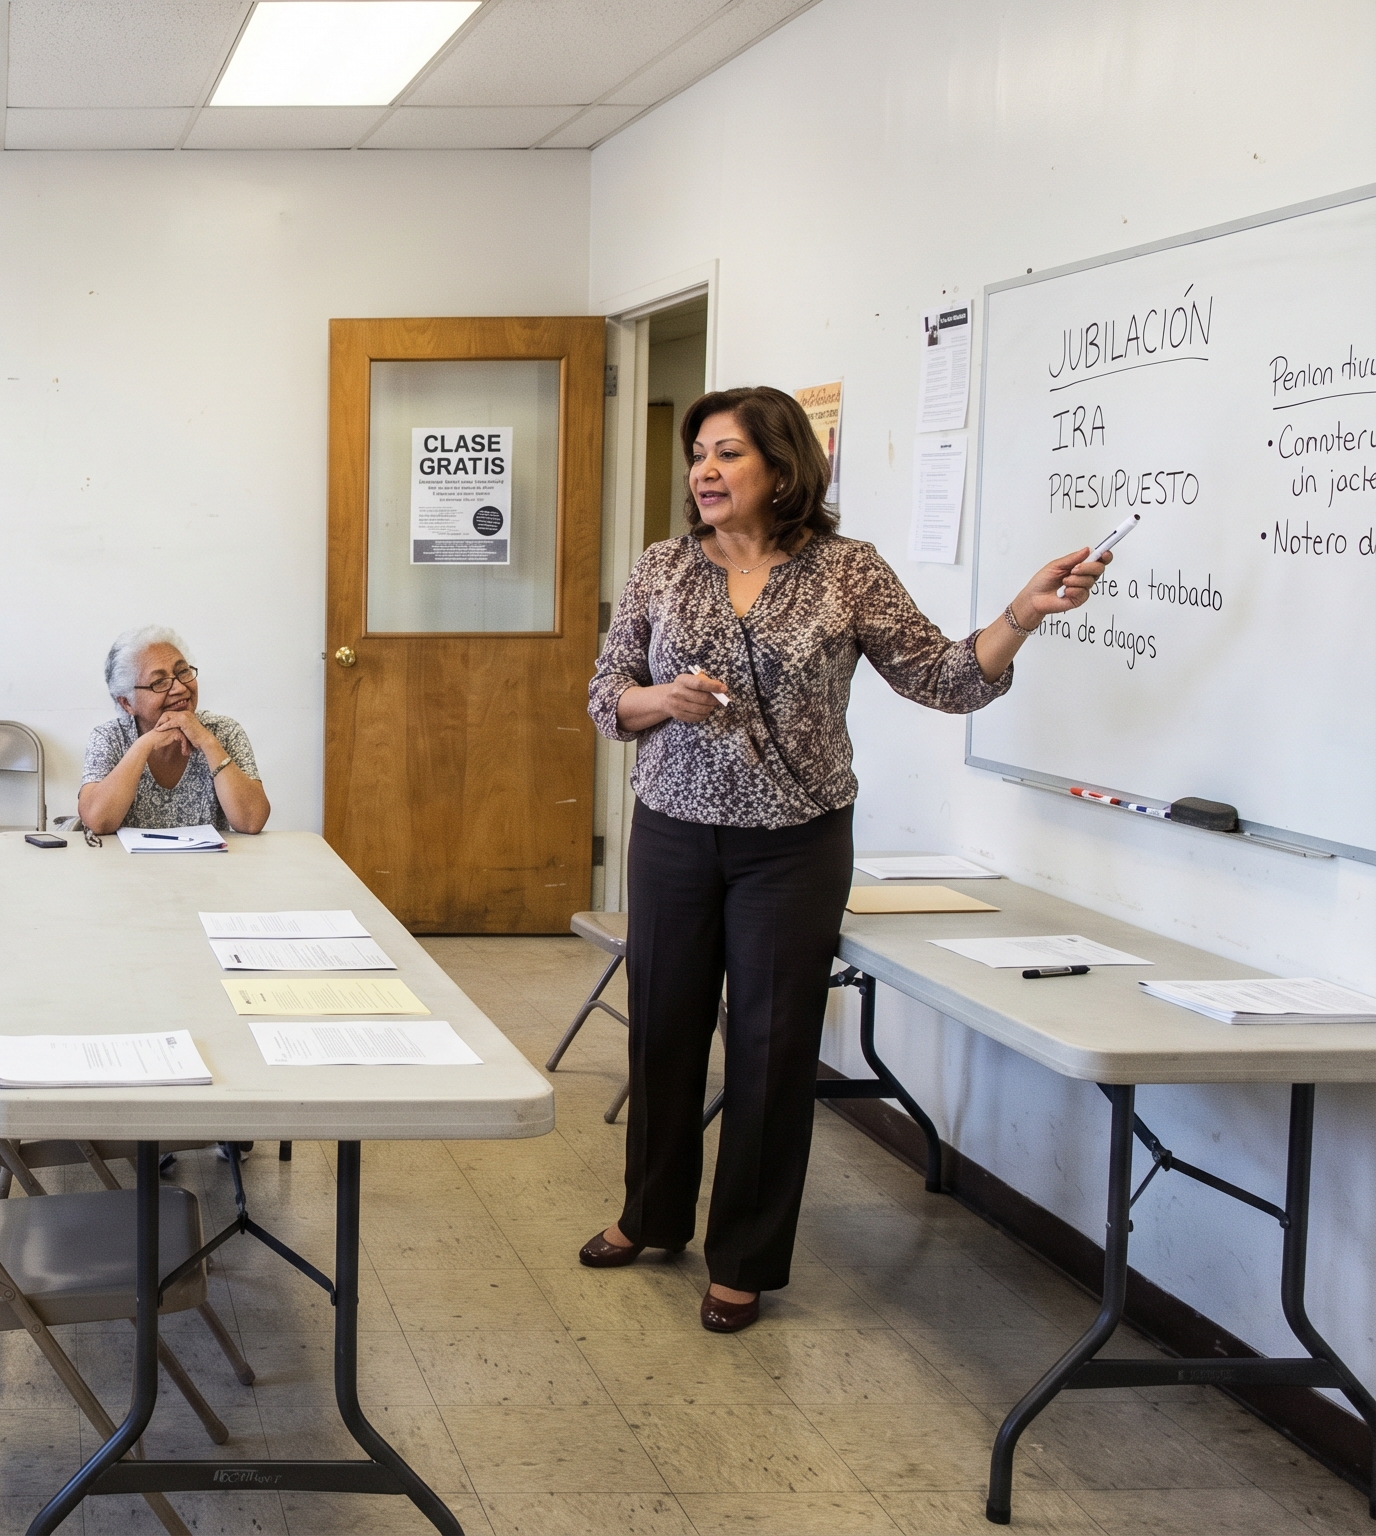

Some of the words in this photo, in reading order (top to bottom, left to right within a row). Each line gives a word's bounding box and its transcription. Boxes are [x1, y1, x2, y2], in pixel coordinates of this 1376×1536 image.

[1048, 283, 1213, 378] JUBILACIÓN
[423, 434, 501, 453] CLASE
[1052, 405, 1105, 451] IRA
[419, 457, 505, 475] GRATIS
[1049, 469, 1199, 514] PRESUPUESTO
[1273, 518, 1347, 556] Notero
[1128, 579, 1139, 600] a
[1077, 612, 1096, 644] de
